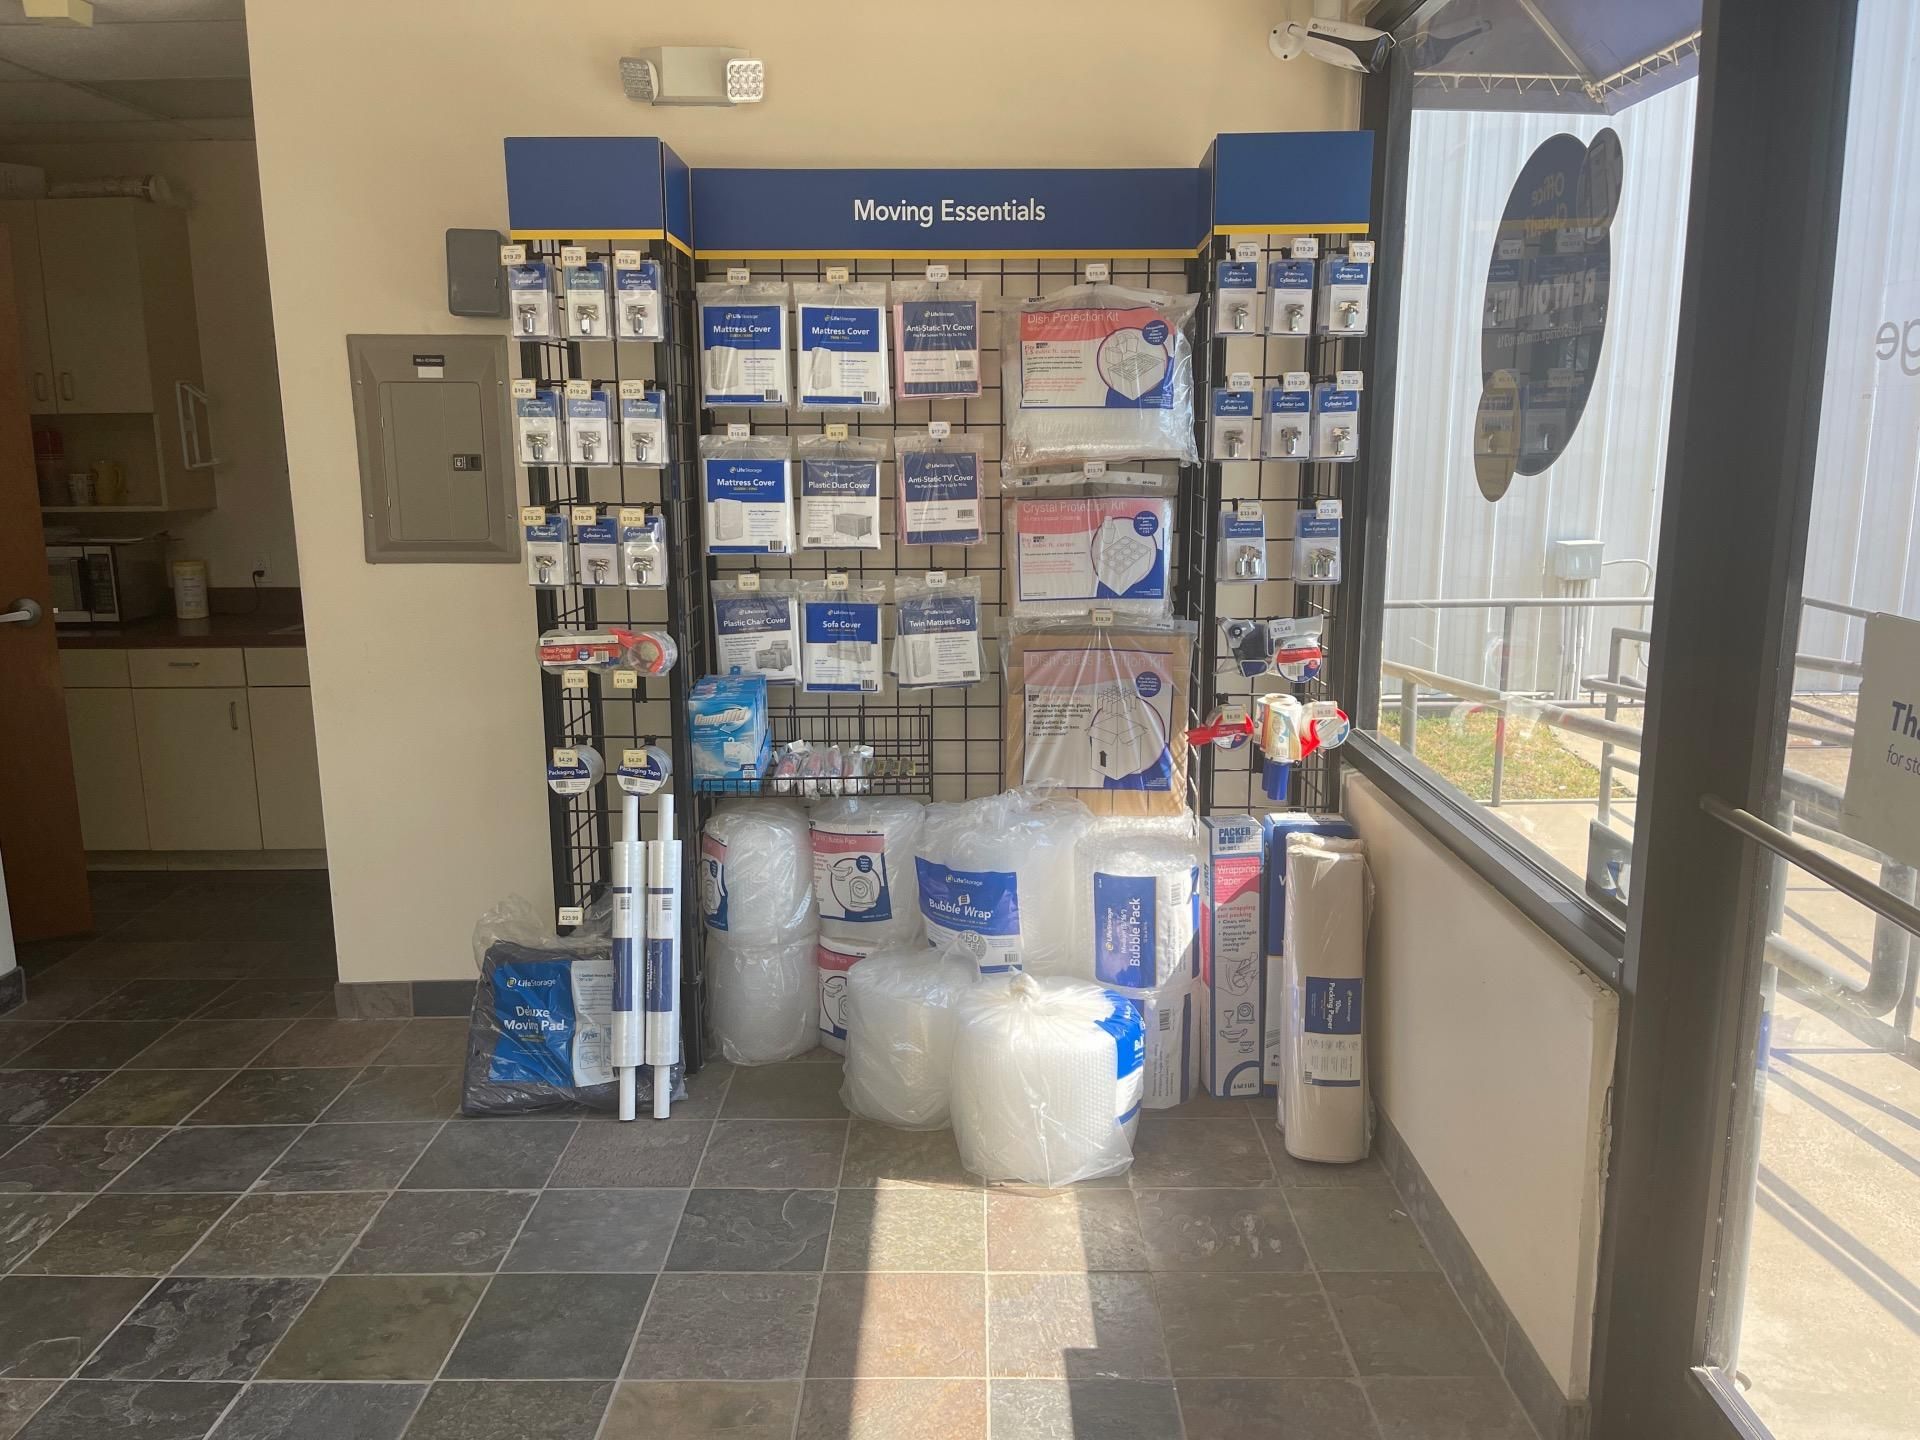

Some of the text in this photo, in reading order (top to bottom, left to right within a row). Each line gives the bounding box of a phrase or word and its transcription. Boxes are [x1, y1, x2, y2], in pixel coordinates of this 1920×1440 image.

[854, 198, 1046, 227] Moving Essentials
[1027, 312, 1119, 324] Dish Protection Kit
[748, 325, 771, 333] Cover
[812, 327, 870, 336] Mattress Cover
[717, 478, 776, 487] Mattress Cover
[808, 481, 830, 489] Plastic
[1023, 501, 1126, 514] Crystal Protection Kit
[723, 617, 787, 627] Plastic Chair Cover
[822, 620, 862, 629] Sofa Cover
[1886, 743, 1904, 767] for
[620, 765, 647, 776] Packaging
[1219, 826, 1251, 837] PACKER
[1217, 865, 1257, 876] Wrapping
[953, 877, 983, 886] LifeStorage
[1218, 877, 1241, 887] Paper
[928, 898, 992, 921] Bubble Wrap
[964, 932, 978, 943] 150
[1129, 898, 1141, 967] Bubble Pack
[517, 979, 556, 987] LifeStorage
[1326, 982, 1336, 1030] Packing Paper
[516, 1006, 550, 1018] Deluxe
[504, 1019, 565, 1034] Moving Pad
